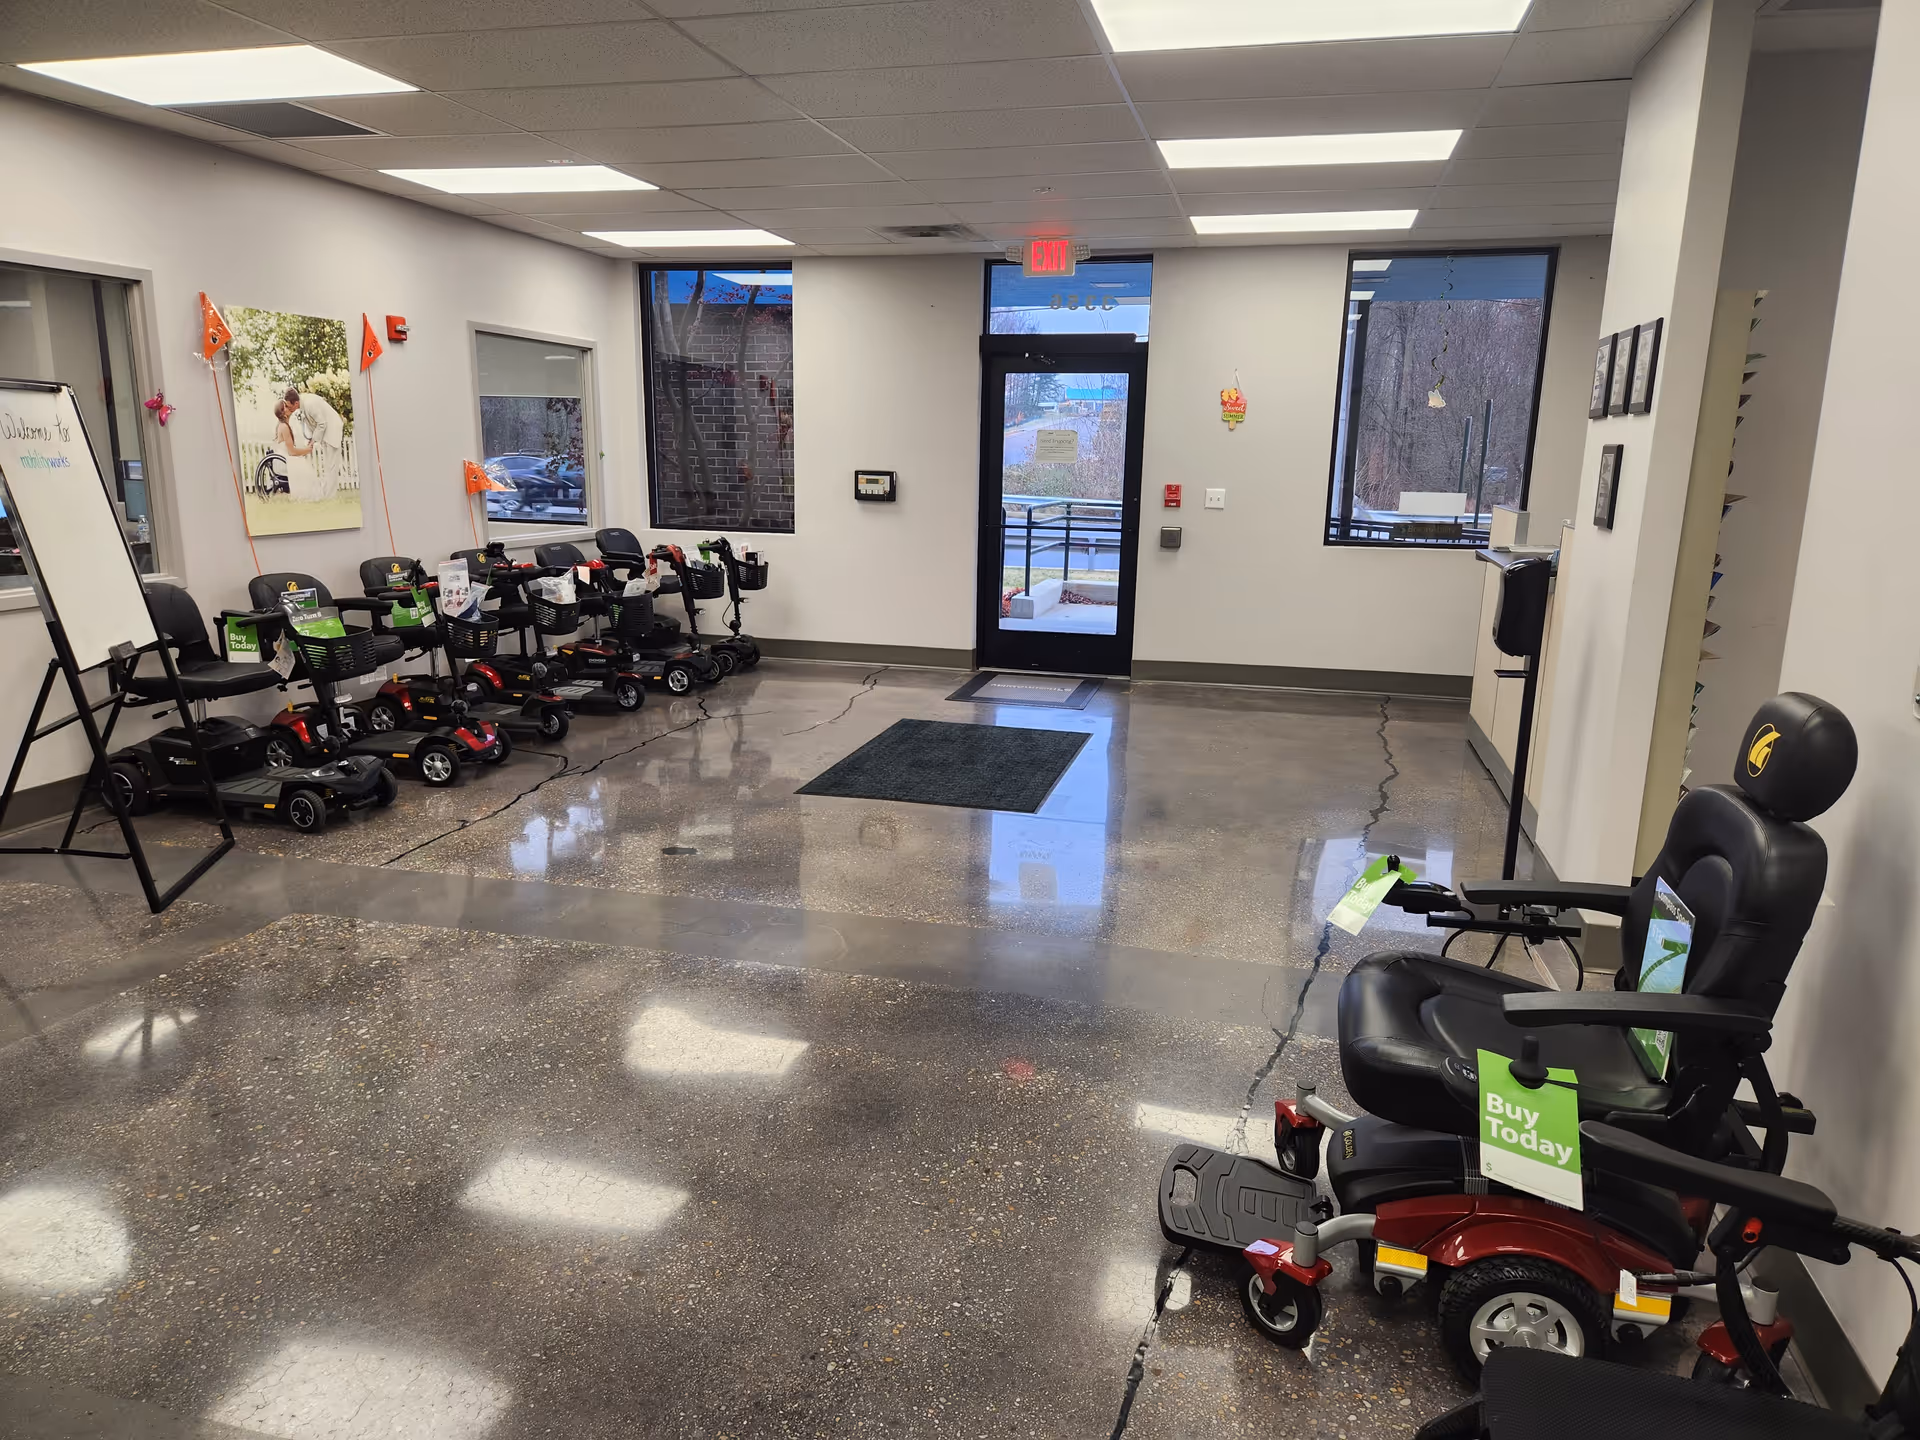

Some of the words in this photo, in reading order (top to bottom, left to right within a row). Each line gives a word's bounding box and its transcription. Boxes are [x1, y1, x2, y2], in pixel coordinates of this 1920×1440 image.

[1031, 240, 1068, 271] EXIT
[0, 413, 51, 441] Welcome
[54, 413, 70, 442] to
[230, 633, 246, 642] Buy
[230, 641, 256, 651] Today
[1486, 1092, 1539, 1129] Buy
[1485, 1115, 1573, 1165] Today
